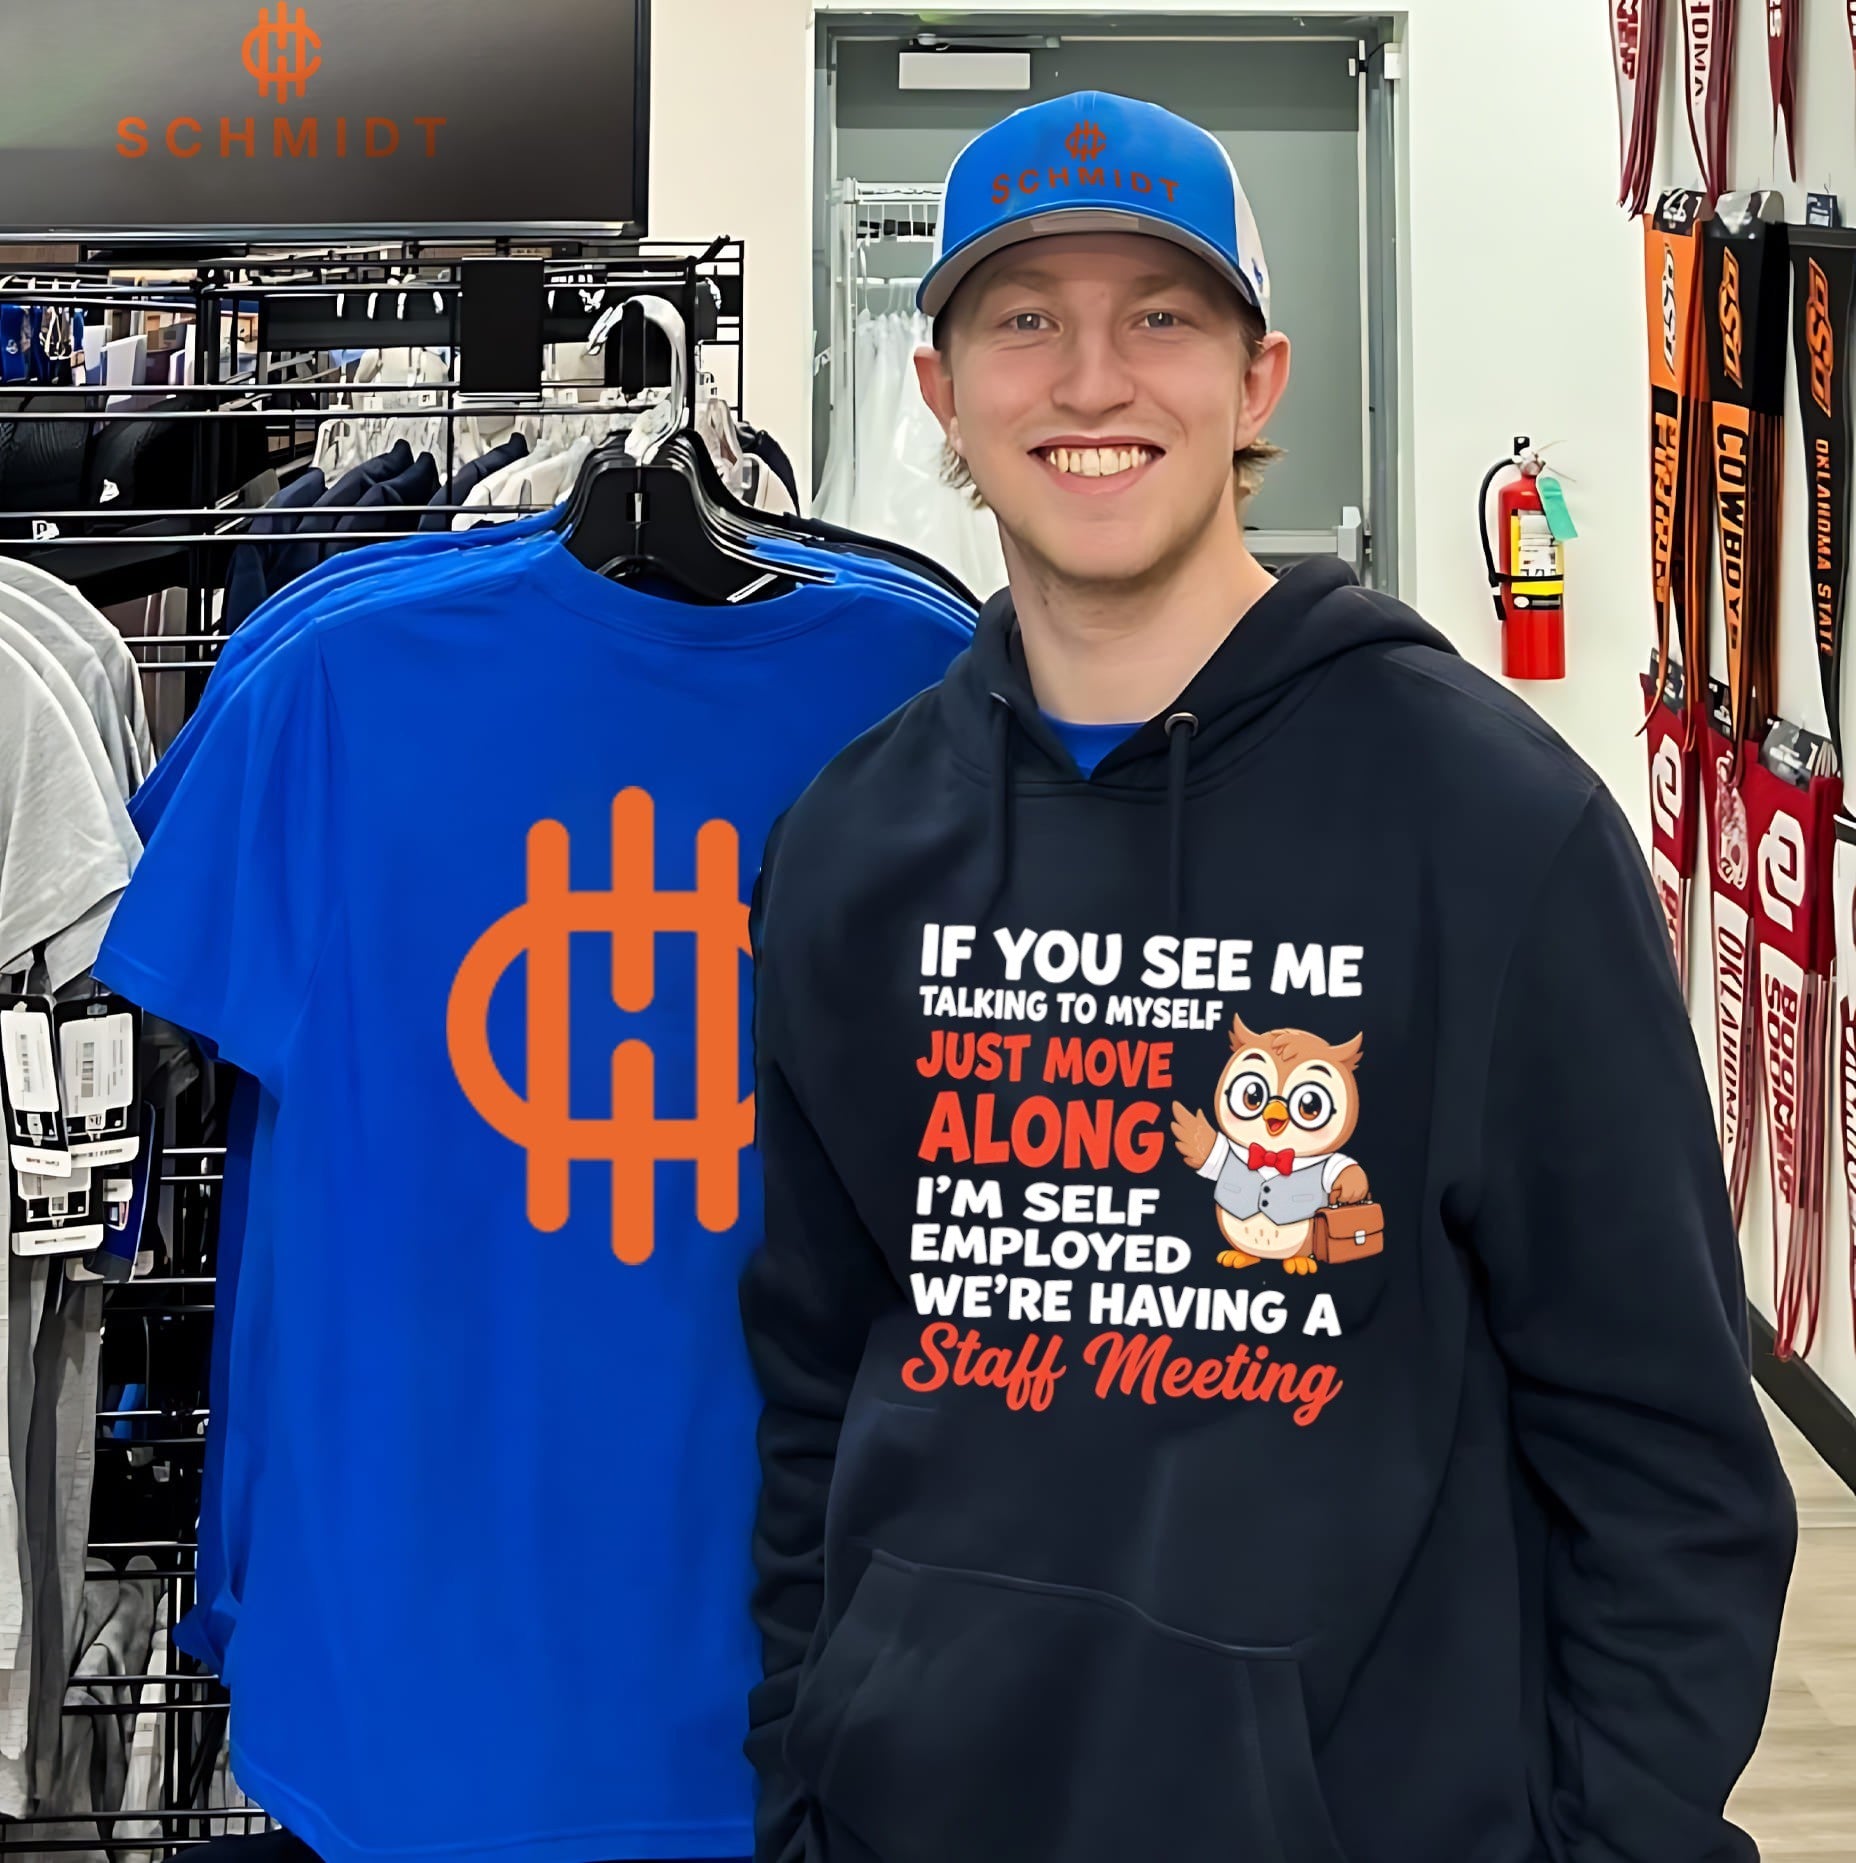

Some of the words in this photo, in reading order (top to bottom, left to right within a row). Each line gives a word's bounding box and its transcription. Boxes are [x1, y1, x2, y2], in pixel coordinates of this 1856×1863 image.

[116, 115, 447, 159] SCHMIDT
[992, 165, 1180, 204] SCHMIDT
[1815, 438, 1831, 570] OKLAHOMA
[1816, 583, 1834, 657] STATE
[919, 923, 977, 978] IF
[993, 927, 1123, 986] YOU
[1140, 935, 1253, 992] SEE
[1270, 942, 1364, 998] ME
[919, 985, 1048, 1022] TALKING
[1056, 992, 1098, 1025] TO
[1104, 995, 1224, 1031] MYSELF
[1718, 926, 1746, 1144] OKLAHOMA
[915, 1030, 1032, 1083] JUST
[1042, 1036, 1174, 1089] MOVE
[917, 1090, 1165, 1174] ALONG
[916, 1176, 1003, 1219] I'M
[1022, 1182, 1160, 1227] SELF
[909, 1223, 1192, 1274] EMPLOYED
[909, 1272, 1073, 1324] WE'RE
[1089, 1282, 1288, 1335] HAVING
[1302, 1293, 1342, 1337] A
[901, 1321, 1067, 1413] Staff
[1082, 1331, 1343, 1427] Meeting
